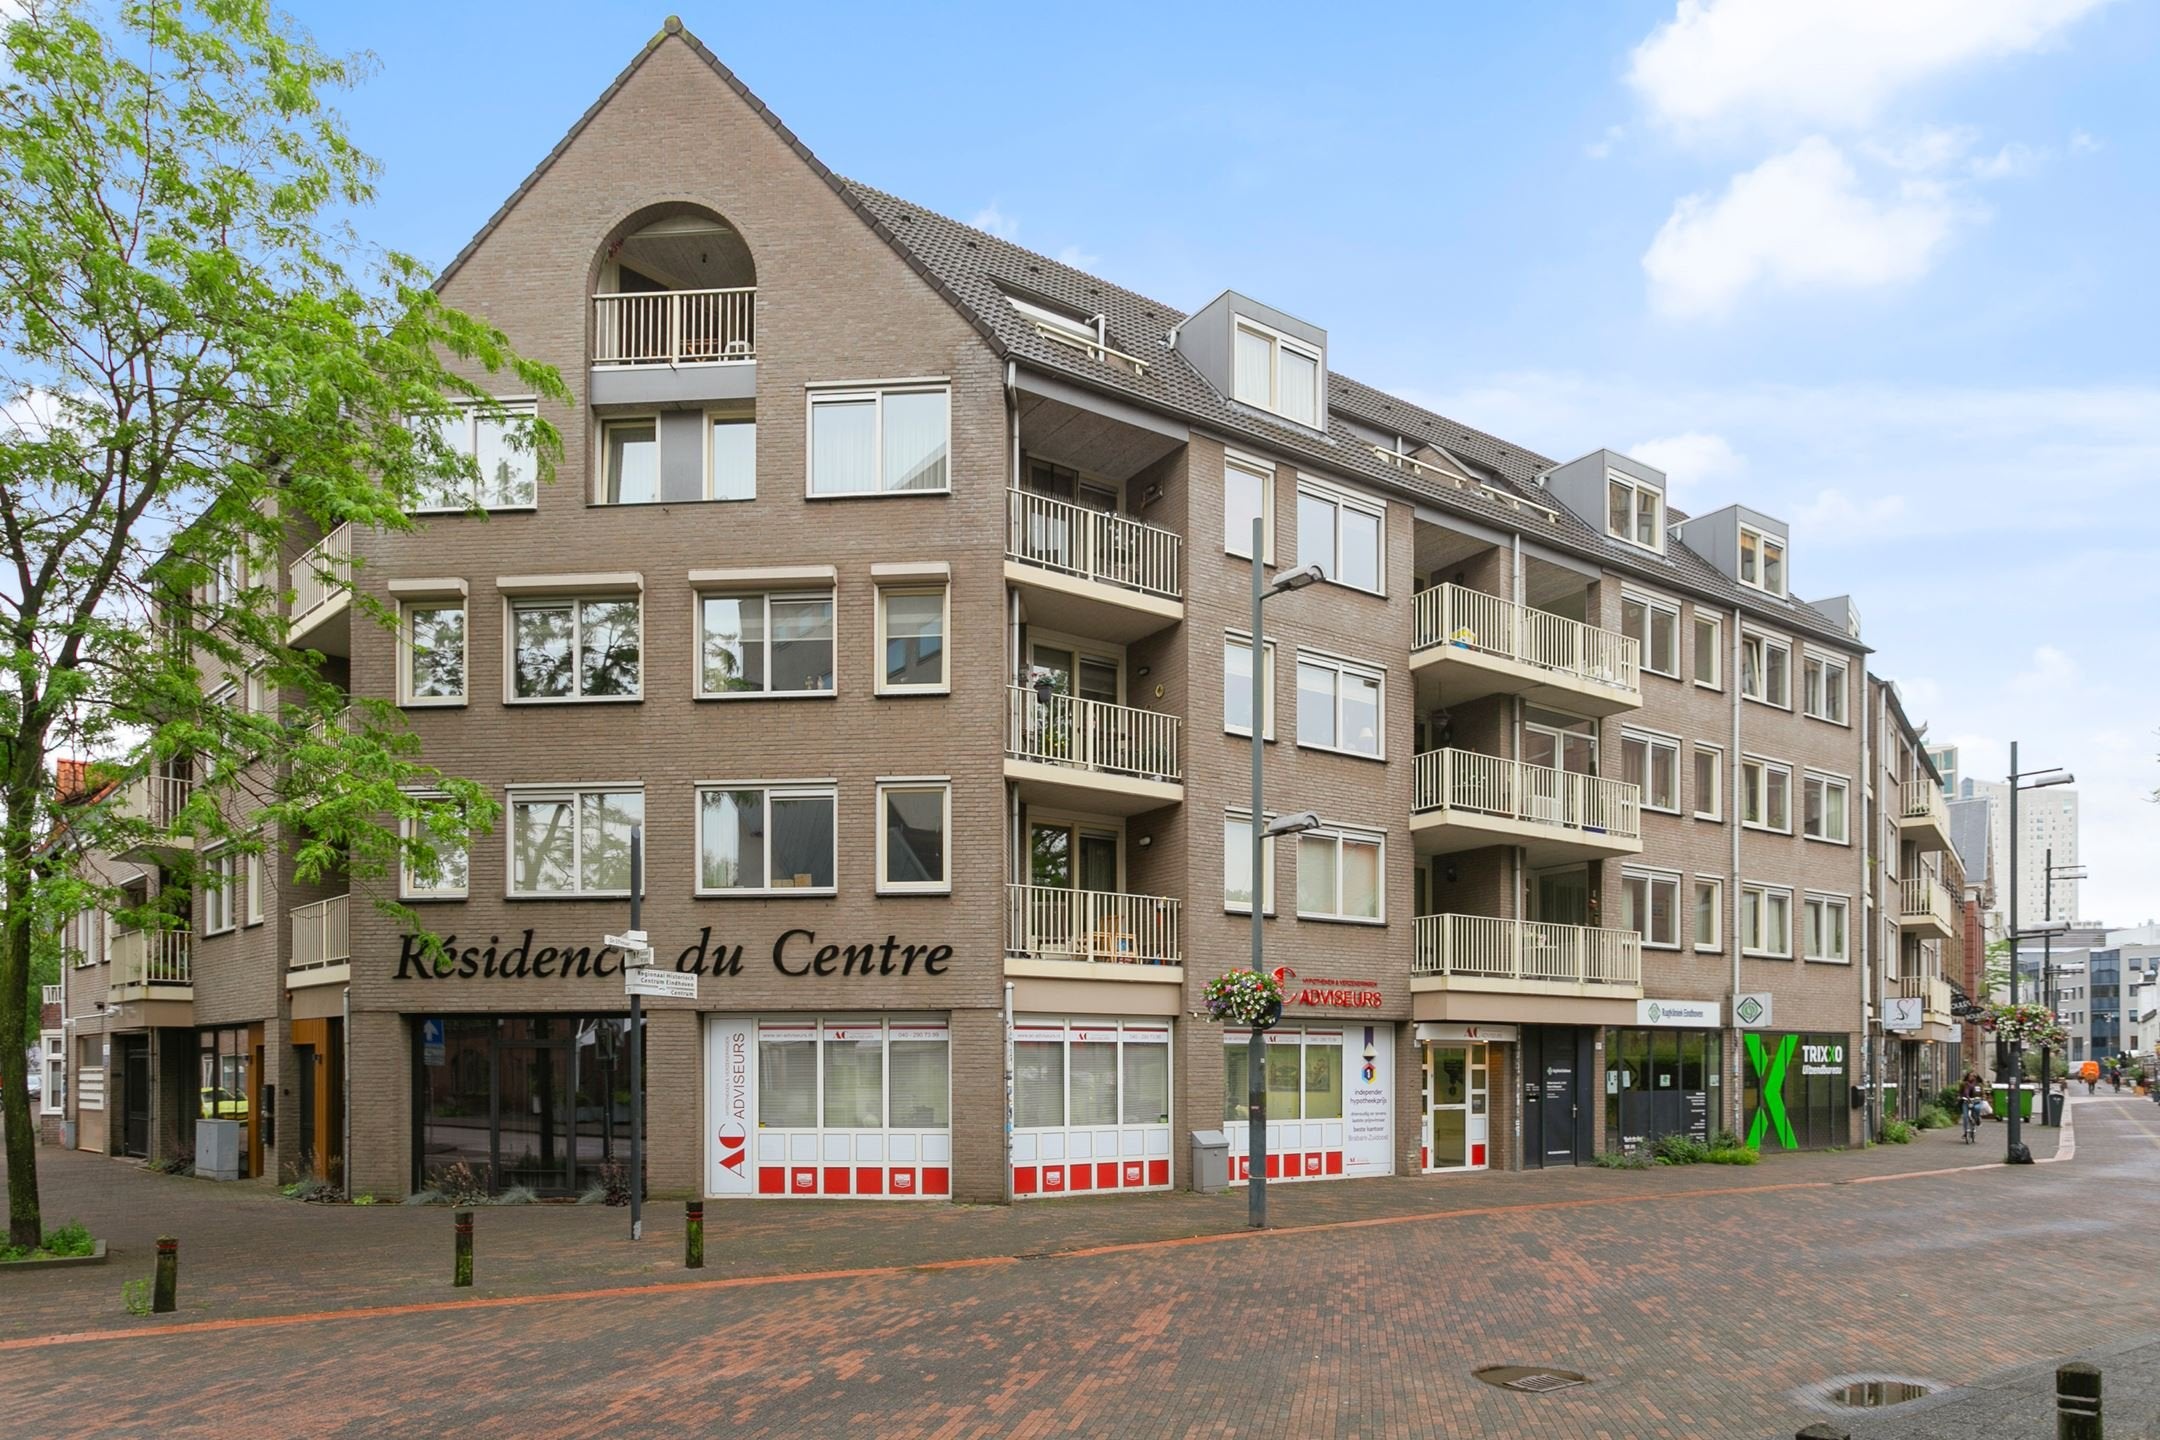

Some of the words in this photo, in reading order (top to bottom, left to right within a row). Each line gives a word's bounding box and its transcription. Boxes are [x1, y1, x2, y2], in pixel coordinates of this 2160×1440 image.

[392, 928, 626, 979] Résidenc
[676, 926, 744, 977] du
[772, 929, 954, 977] Centre
[637, 970, 666, 978] Regionaal
[640, 977, 665, 985] Centrum
[1300, 989, 1382, 1008] ADVISEURS
[1802, 1045, 1843, 1063] TRIXXO
[718, 1122, 746, 1179] AC
[733, 1032, 745, 1120] ADVISEURS
